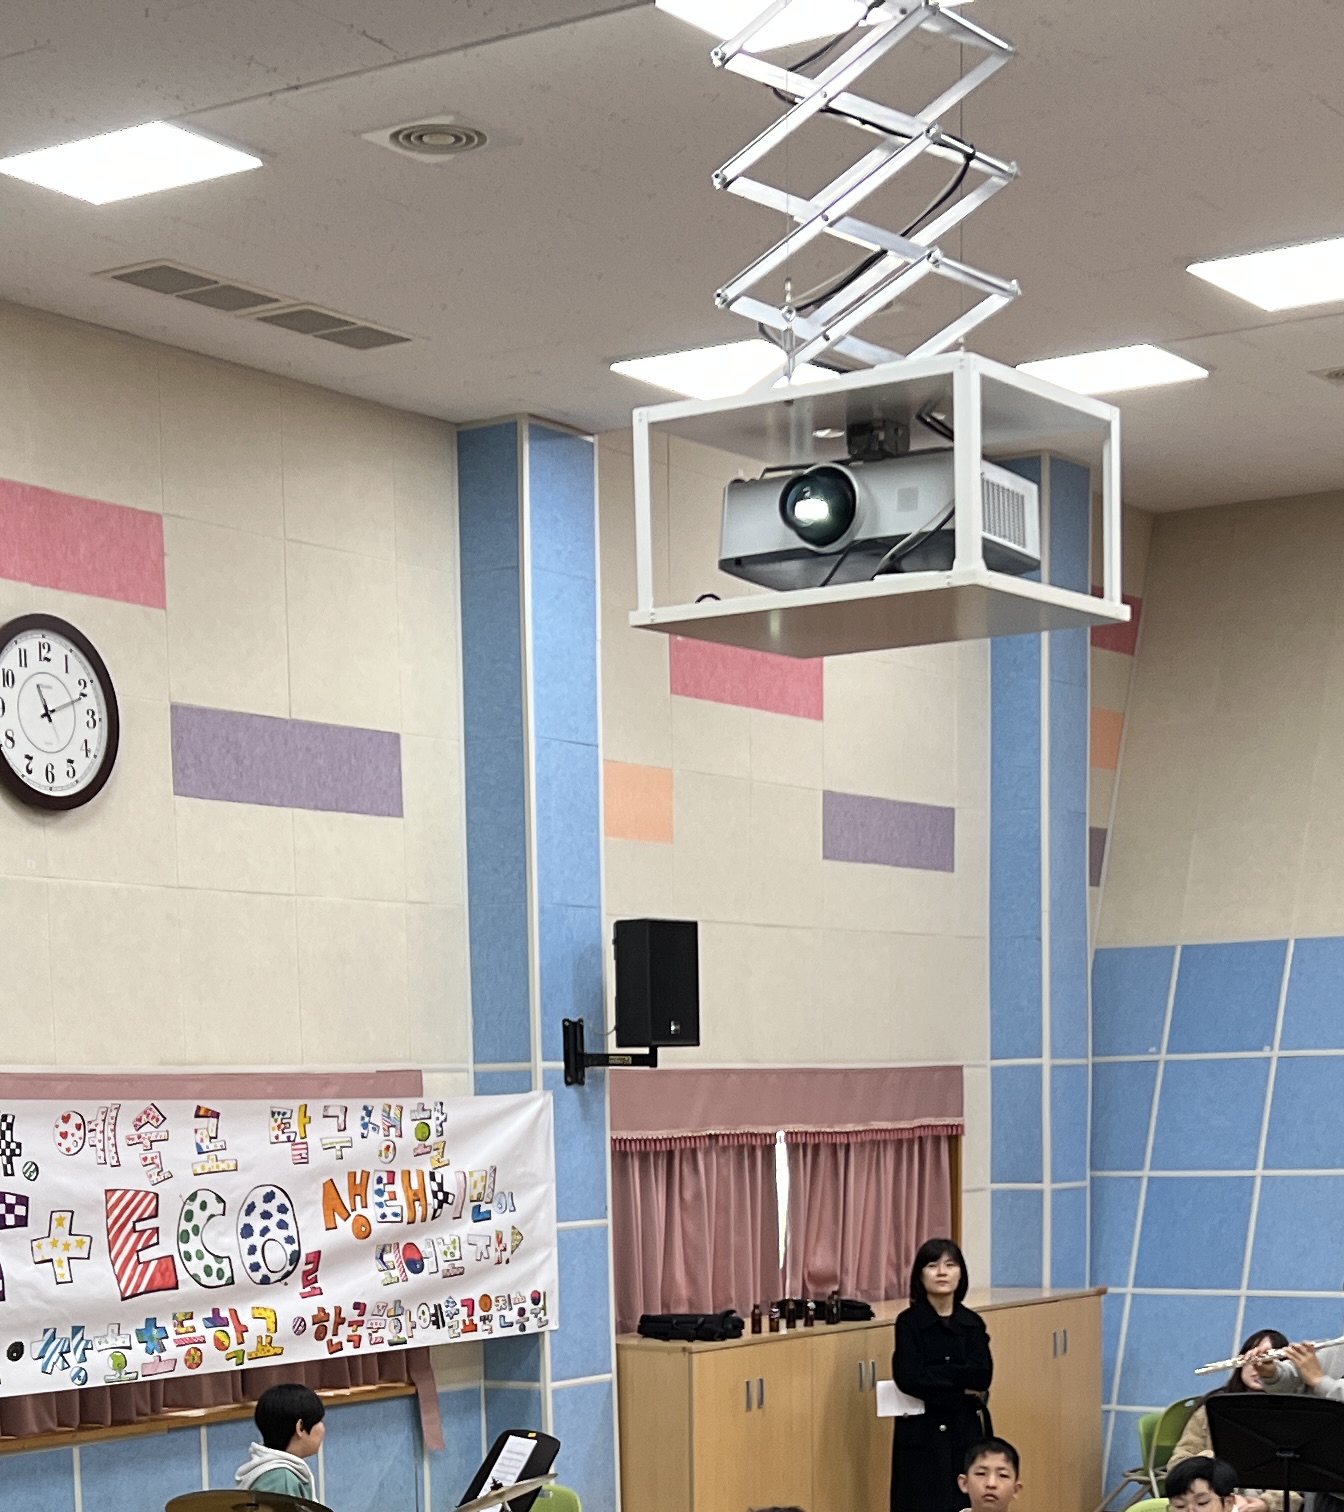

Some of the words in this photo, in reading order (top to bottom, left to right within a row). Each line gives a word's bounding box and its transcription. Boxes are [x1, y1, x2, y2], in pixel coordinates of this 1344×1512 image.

[17, 647, 28, 668] 11
[38, 641, 52, 663] 12
[64, 654, 70, 674] 1
[2, 668, 15, 689] 10
[77, 678, 88, 699] 2
[86, 709, 97, 729] 3
[4, 728, 16, 750] 8
[79, 738, 92, 758] 4
[24, 754, 34, 775] 7
[45, 762, 55, 784] 6
[66, 758, 76, 779] 5
